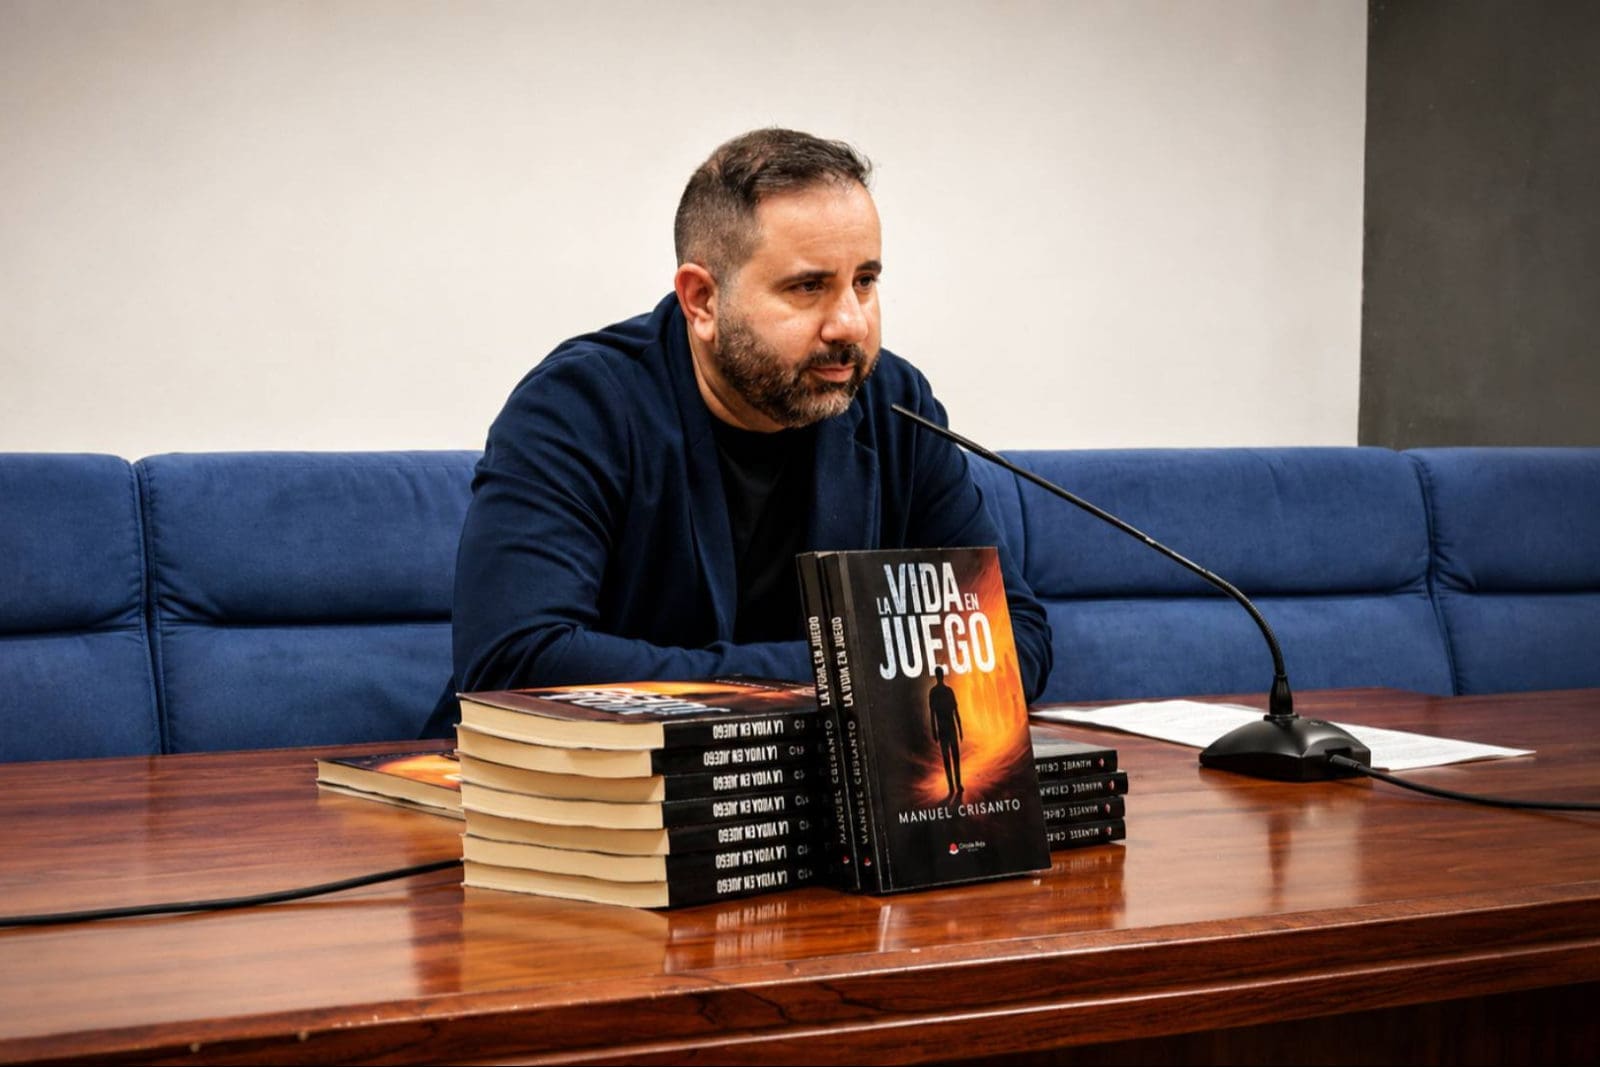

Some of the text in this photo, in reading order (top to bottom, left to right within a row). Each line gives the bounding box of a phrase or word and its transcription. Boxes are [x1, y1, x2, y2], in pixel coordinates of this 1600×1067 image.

[876, 562, 980, 615] LA VIDA EN
[808, 616, 823, 649] JUEGO
[831, 616, 846, 649] JUEGO
[879, 612, 996, 680] JUEGO
[819, 691, 831, 706] LA
[842, 692, 854, 707] LA
[713, 724, 738, 739] JUEGO
[740, 723, 750, 737] EN
[773, 720, 784, 734] LA
[703, 750, 730, 766] JUEGO
[732, 749, 743, 763] EN
[768, 745, 778, 760] LA
[713, 774, 739, 790] JUEGO
[740, 773, 750, 787] EN
[773, 769, 783, 783] LA
[713, 801, 738, 817] JUEGO
[740, 799, 751, 814] EN
[775, 796, 785, 810] LA
[898, 798, 1021, 824] MANUEL CRISANTO
[718, 827, 743, 843] JUEGO
[745, 825, 756, 839] EN
[779, 821, 789, 834] LA
[742, 850, 753, 865] EN
[777, 845, 787, 860] LA
[715, 853, 741, 869] JUEGO
[717, 877, 742, 893] JUEGO
[744, 875, 755, 890] EN
[778, 870, 788, 885] LA
